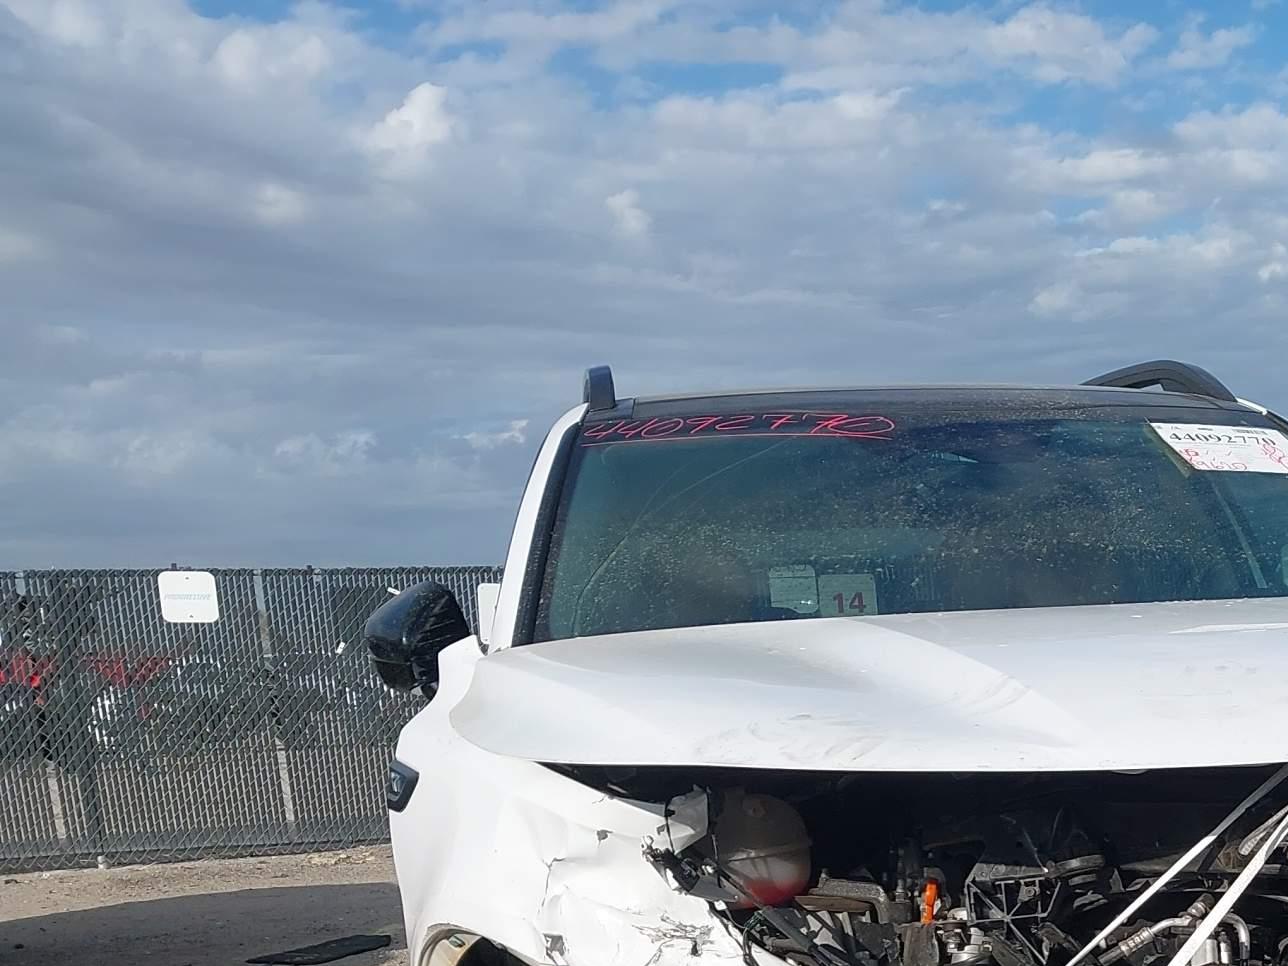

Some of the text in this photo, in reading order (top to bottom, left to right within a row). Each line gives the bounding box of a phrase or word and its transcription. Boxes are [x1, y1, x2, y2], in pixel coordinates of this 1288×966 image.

[583, 411, 895, 440] 44092770
[1169, 432, 1277, 446] 44092770
[832, 591, 867, 614] 14
